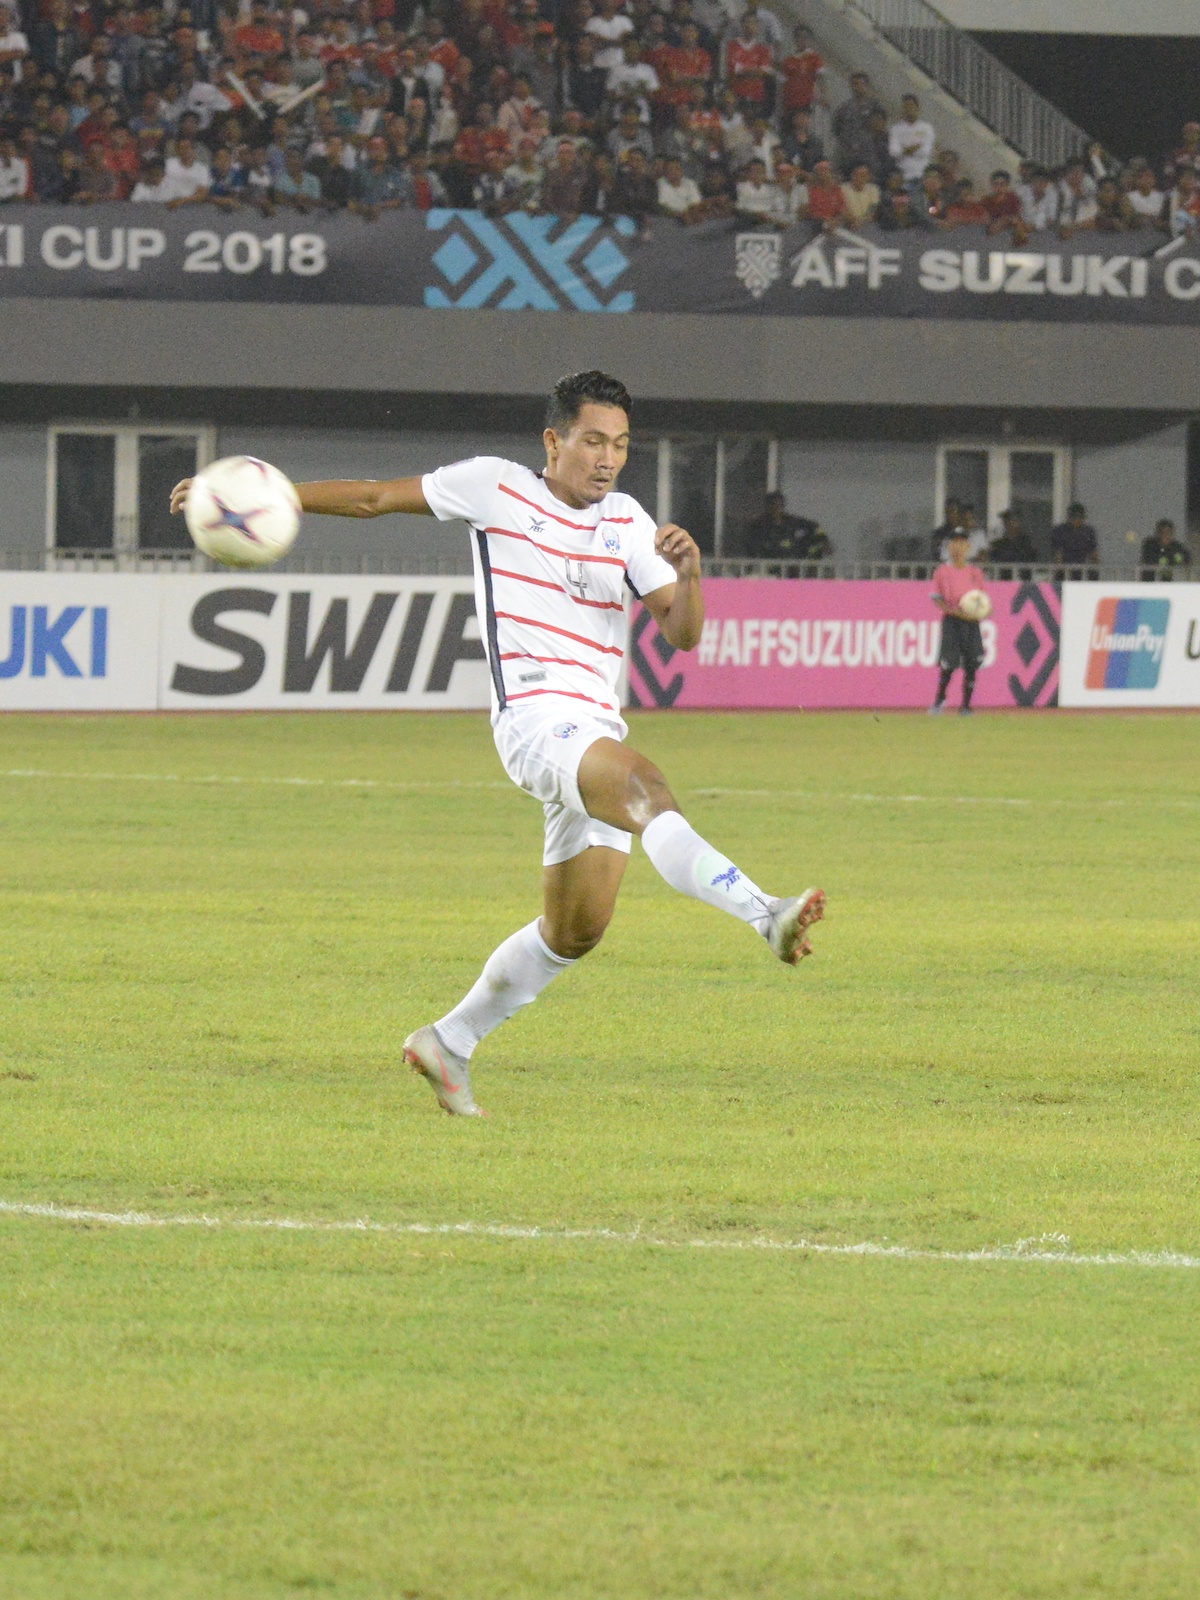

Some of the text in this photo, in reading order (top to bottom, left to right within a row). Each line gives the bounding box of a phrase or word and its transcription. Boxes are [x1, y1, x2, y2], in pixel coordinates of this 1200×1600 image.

[41, 225, 166, 271] CUP
[182, 231, 328, 276] 2018
[792, 247, 901, 290] AFF
[919, 250, 1147, 298] SUZUKI
[565, 556, 588, 601] 4
